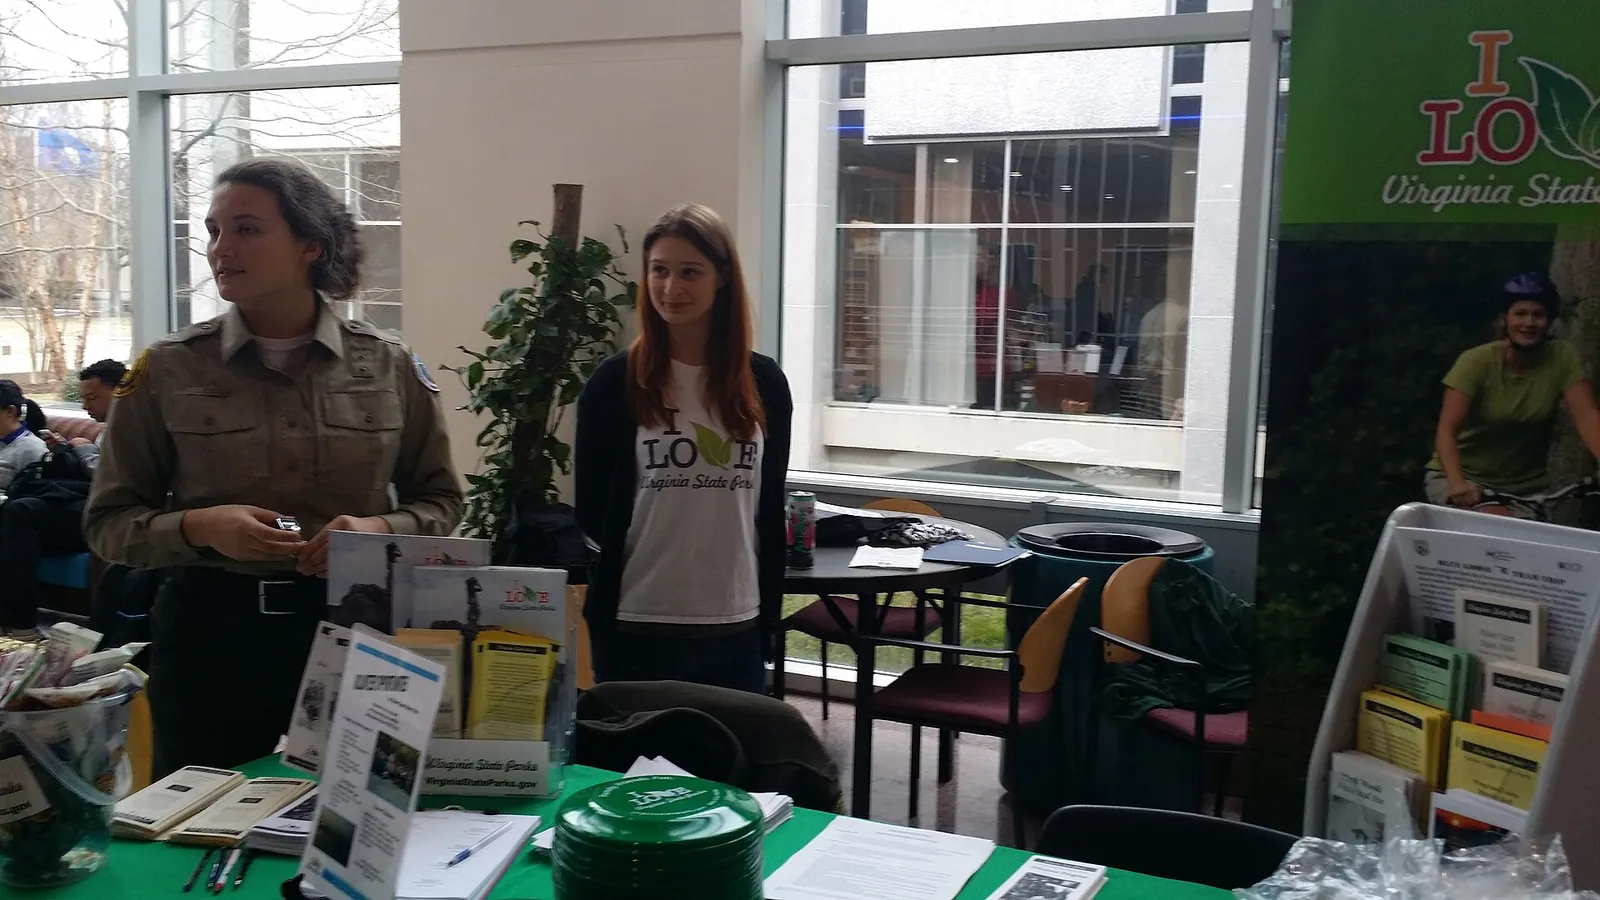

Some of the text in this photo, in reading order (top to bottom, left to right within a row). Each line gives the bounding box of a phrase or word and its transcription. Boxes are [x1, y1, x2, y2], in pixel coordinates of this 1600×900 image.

[1465, 30, 1513, 97] I
[1381, 174, 1514, 213] Virginia
[692, 474, 728, 489] State
[475, 758, 504, 771] State
[504, 759, 538, 773] Parks
